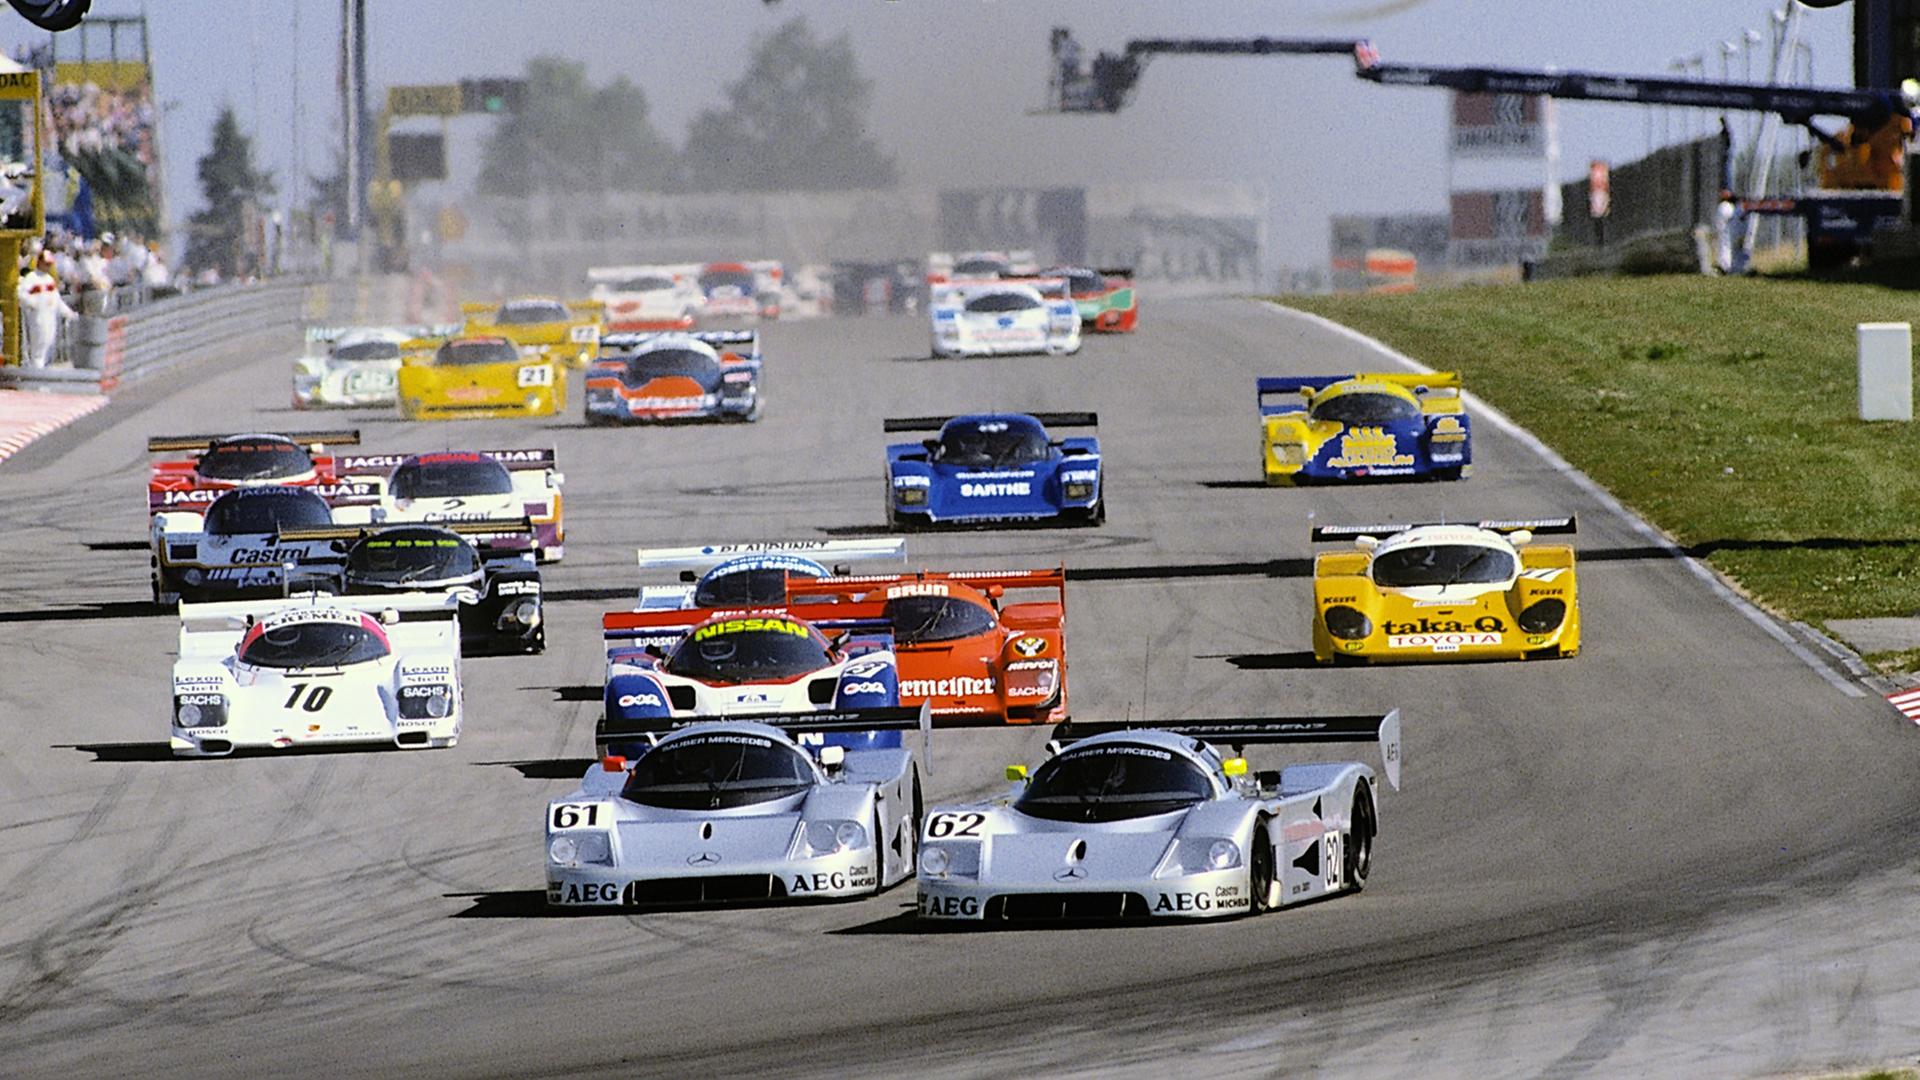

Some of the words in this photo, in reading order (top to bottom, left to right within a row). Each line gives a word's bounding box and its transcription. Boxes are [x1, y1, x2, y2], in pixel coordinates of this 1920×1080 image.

[525, 367, 546, 383] 21
[960, 482, 1032, 497] SARTHE
[229, 546, 308, 566] Castrol
[710, 562, 758, 580] JOEST
[762, 563, 824, 579] RACING
[887, 583, 950, 600] BRUN
[264, 611, 359, 629] KREMER
[1380, 616, 1509, 636] taka-Q
[694, 618, 810, 643] NISSAN
[1393, 634, 1498, 646] TOYOTA
[402, 666, 449, 675] Lexon
[176, 675, 224, 686] Lexon
[180, 694, 222, 706] SACHS
[284, 683, 334, 713] 10
[403, 686, 445, 699] SACHS
[1008, 687, 1050, 698] SACHS
[661, 737, 704, 753] SAUBER
[706, 735, 771, 748] MERCEDES
[1106, 747, 1171, 761] MERCEDES
[553, 804, 599, 829] 61
[927, 812, 986, 839] 62
[1324, 835, 1339, 887] 62
[791, 872, 846, 892] AEG
[566, 883, 618, 903] AEG
[1154, 892, 1211, 911] AEG
[929, 896, 979, 915] AEG
